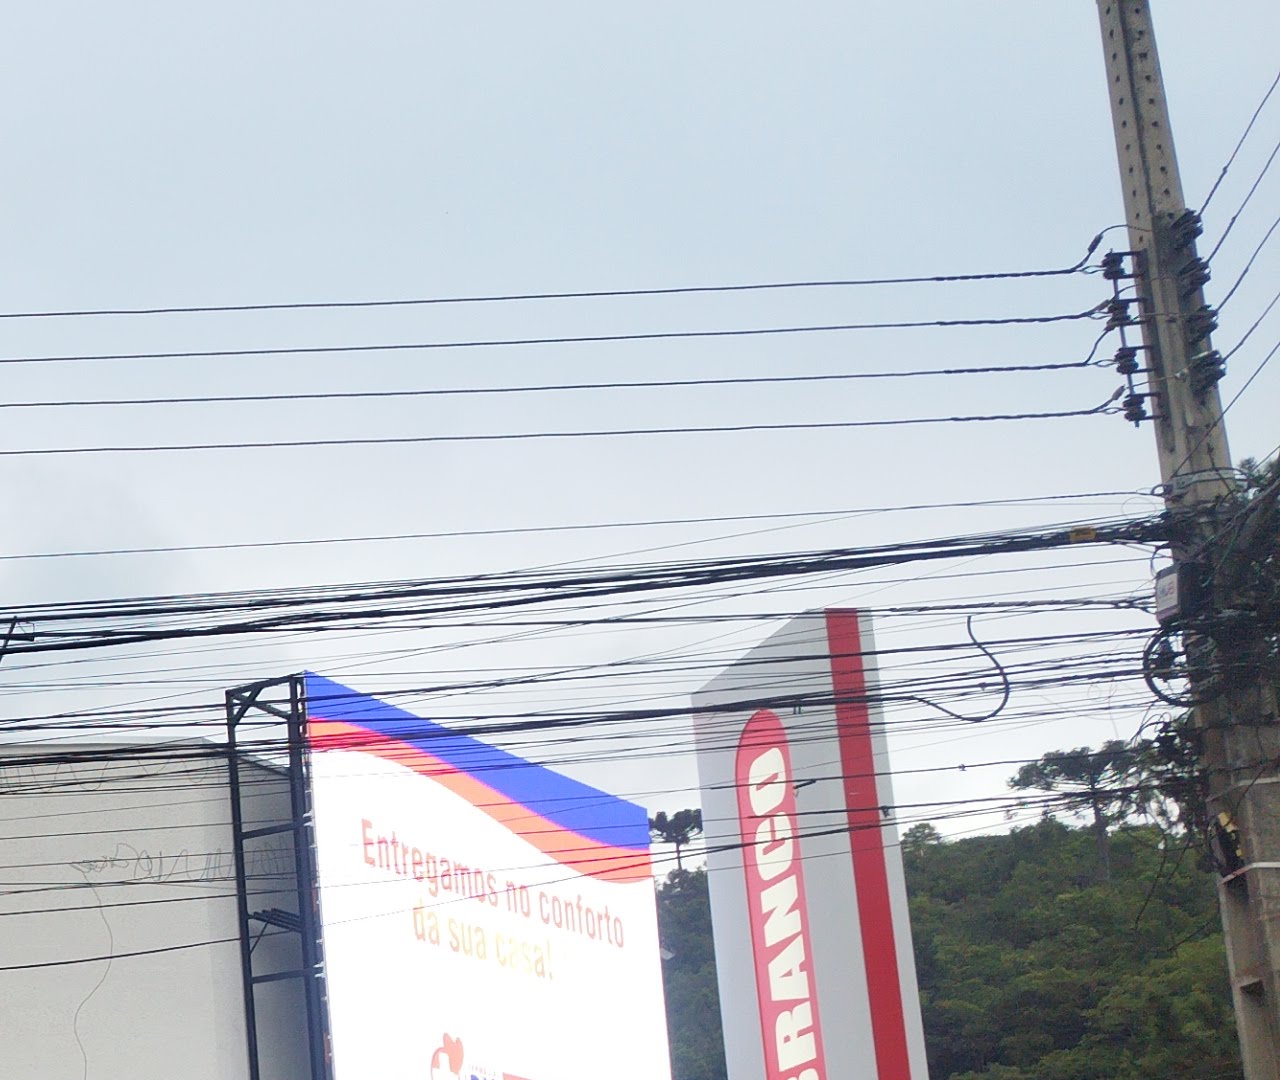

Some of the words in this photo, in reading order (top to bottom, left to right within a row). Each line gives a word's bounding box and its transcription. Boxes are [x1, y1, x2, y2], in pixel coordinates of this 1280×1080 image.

[360, 817, 499, 909] Entregamos
[505, 879, 531, 918] no
[538, 890, 625, 948] conforto
[412, 899, 441, 947] da
[448, 915, 487, 961] sua
[495, 931, 554, 981] casa!
